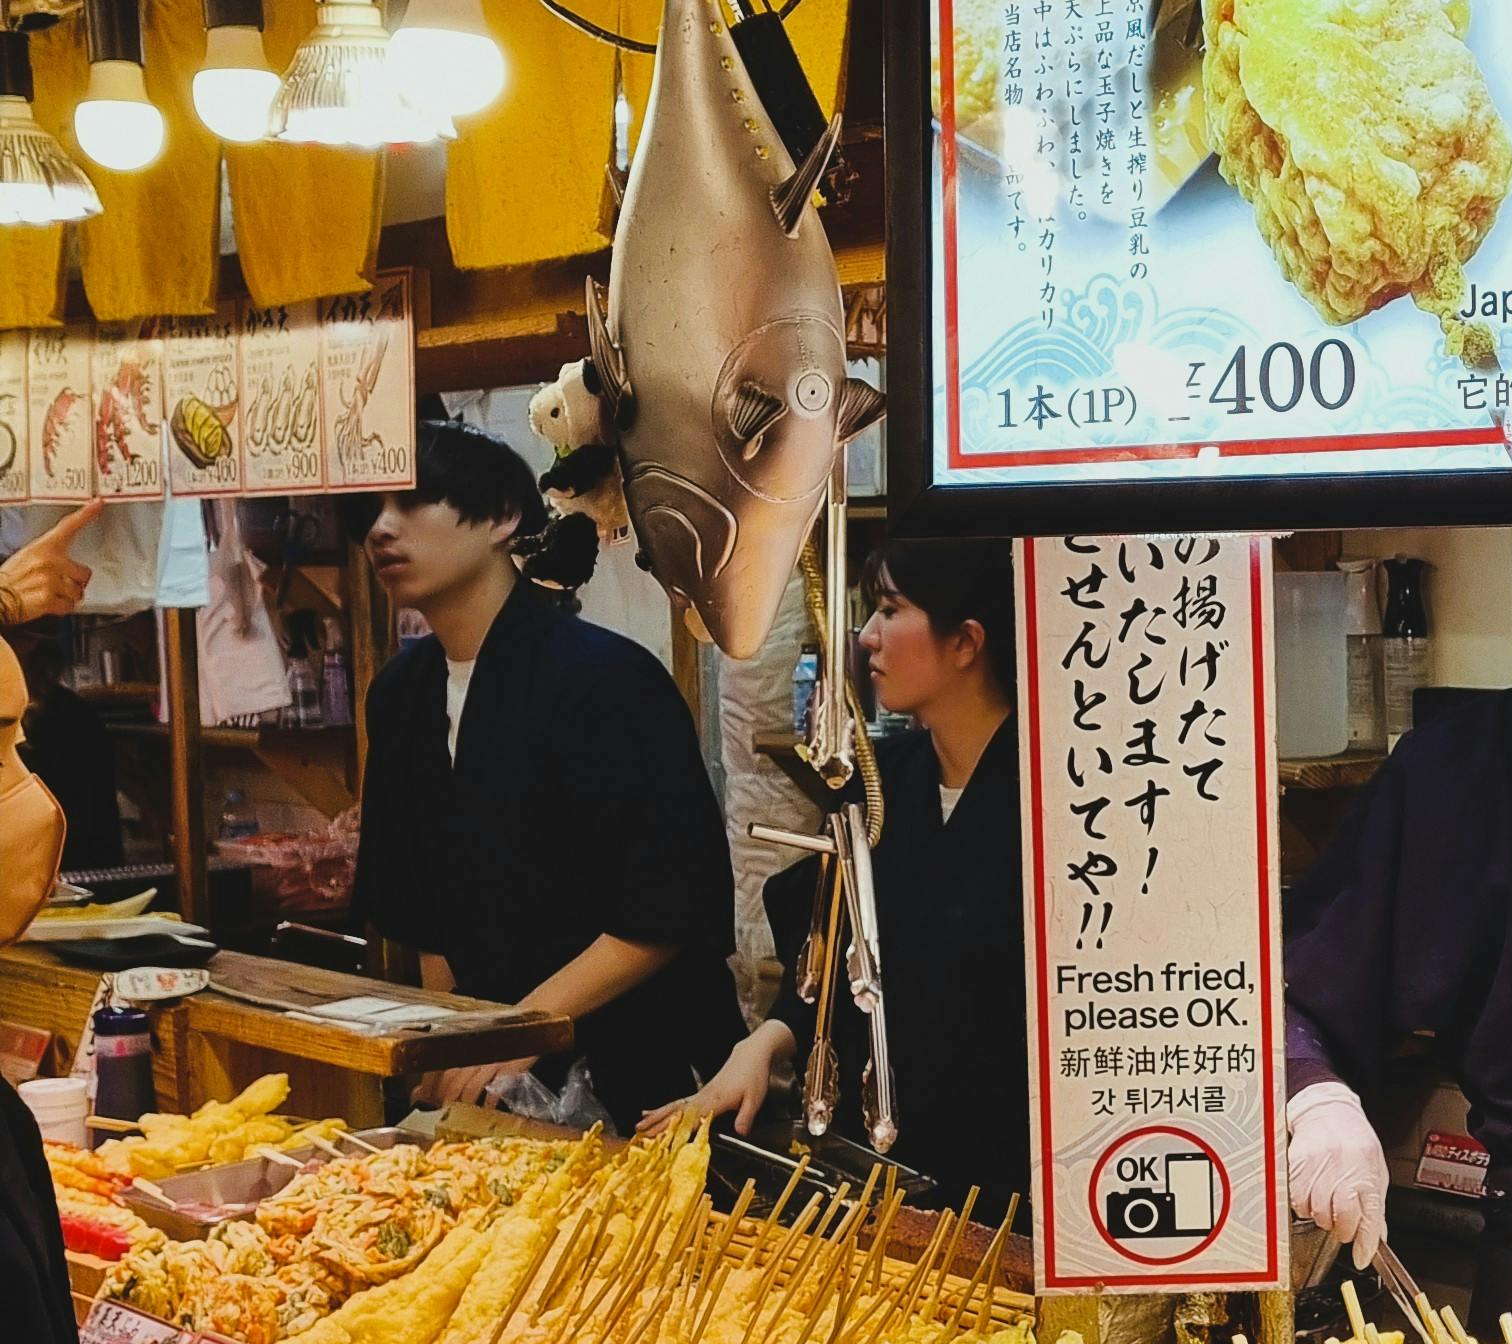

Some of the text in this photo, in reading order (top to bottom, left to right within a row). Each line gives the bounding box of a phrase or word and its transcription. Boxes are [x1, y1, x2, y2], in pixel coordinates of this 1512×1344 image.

[1055, 960, 1256, 997] Fresh fried,
[1063, 997, 1250, 1037] please OK.
[1058, 1041, 1257, 1080] 新鲜油炸好的
[1123, 1086, 1227, 1116] 튀겨서콜
[1115, 1157, 1158, 1183] OK
